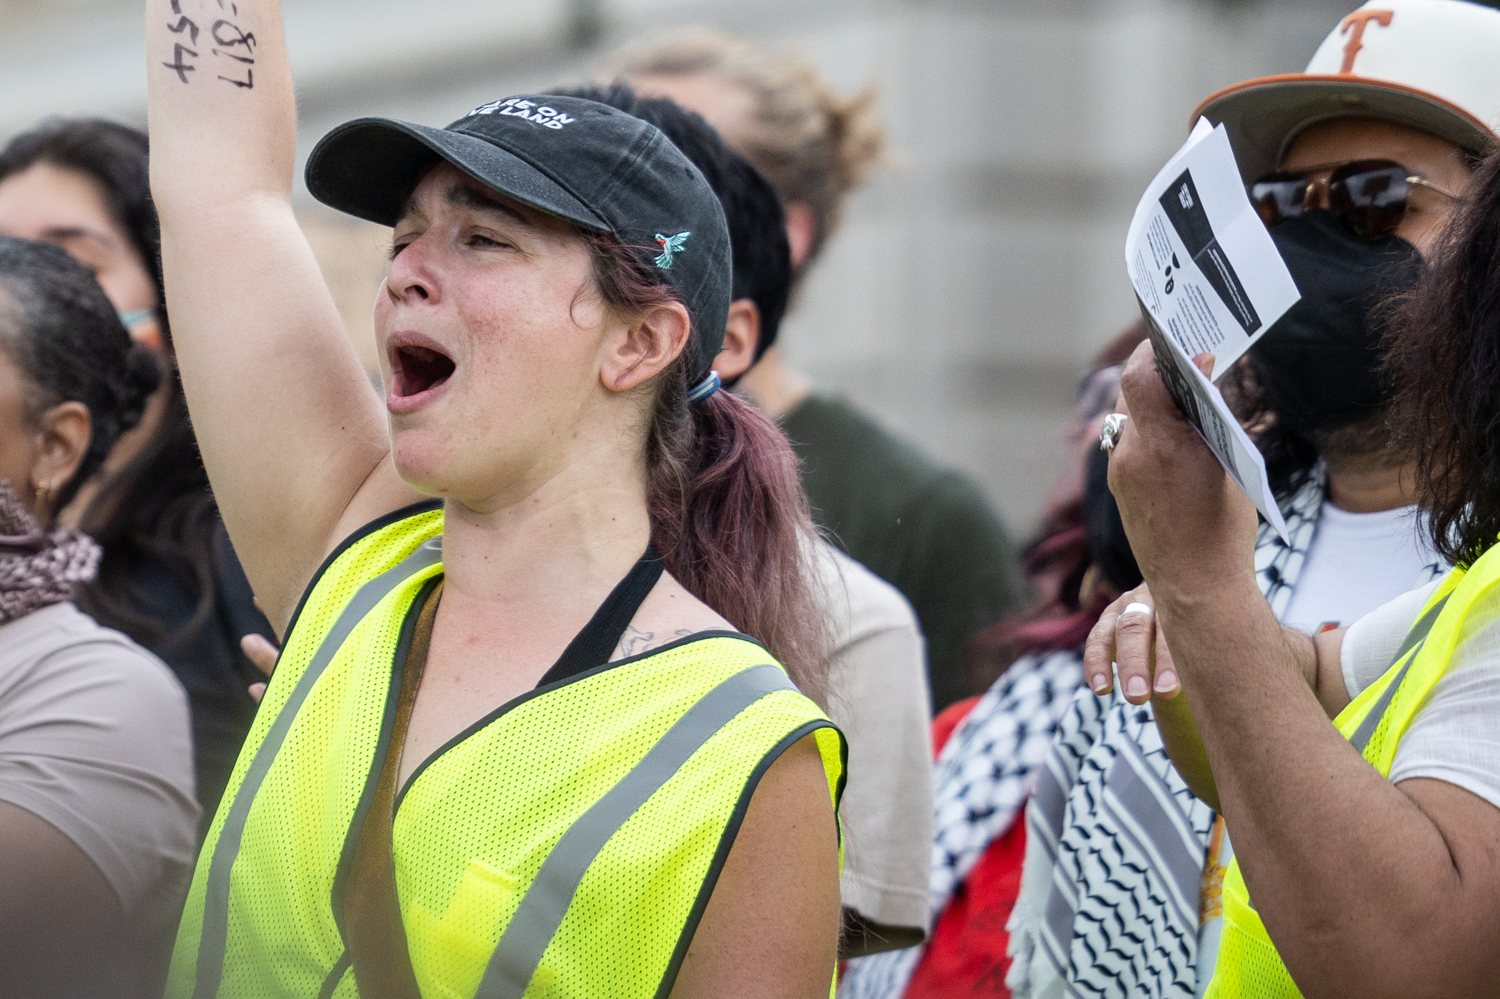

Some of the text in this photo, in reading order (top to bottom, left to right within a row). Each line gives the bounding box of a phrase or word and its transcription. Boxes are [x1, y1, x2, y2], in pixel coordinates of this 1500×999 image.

[1340, 9, 1394, 74] T
[499, 106, 564, 129] LAND
[537, 106, 576, 124] ON
